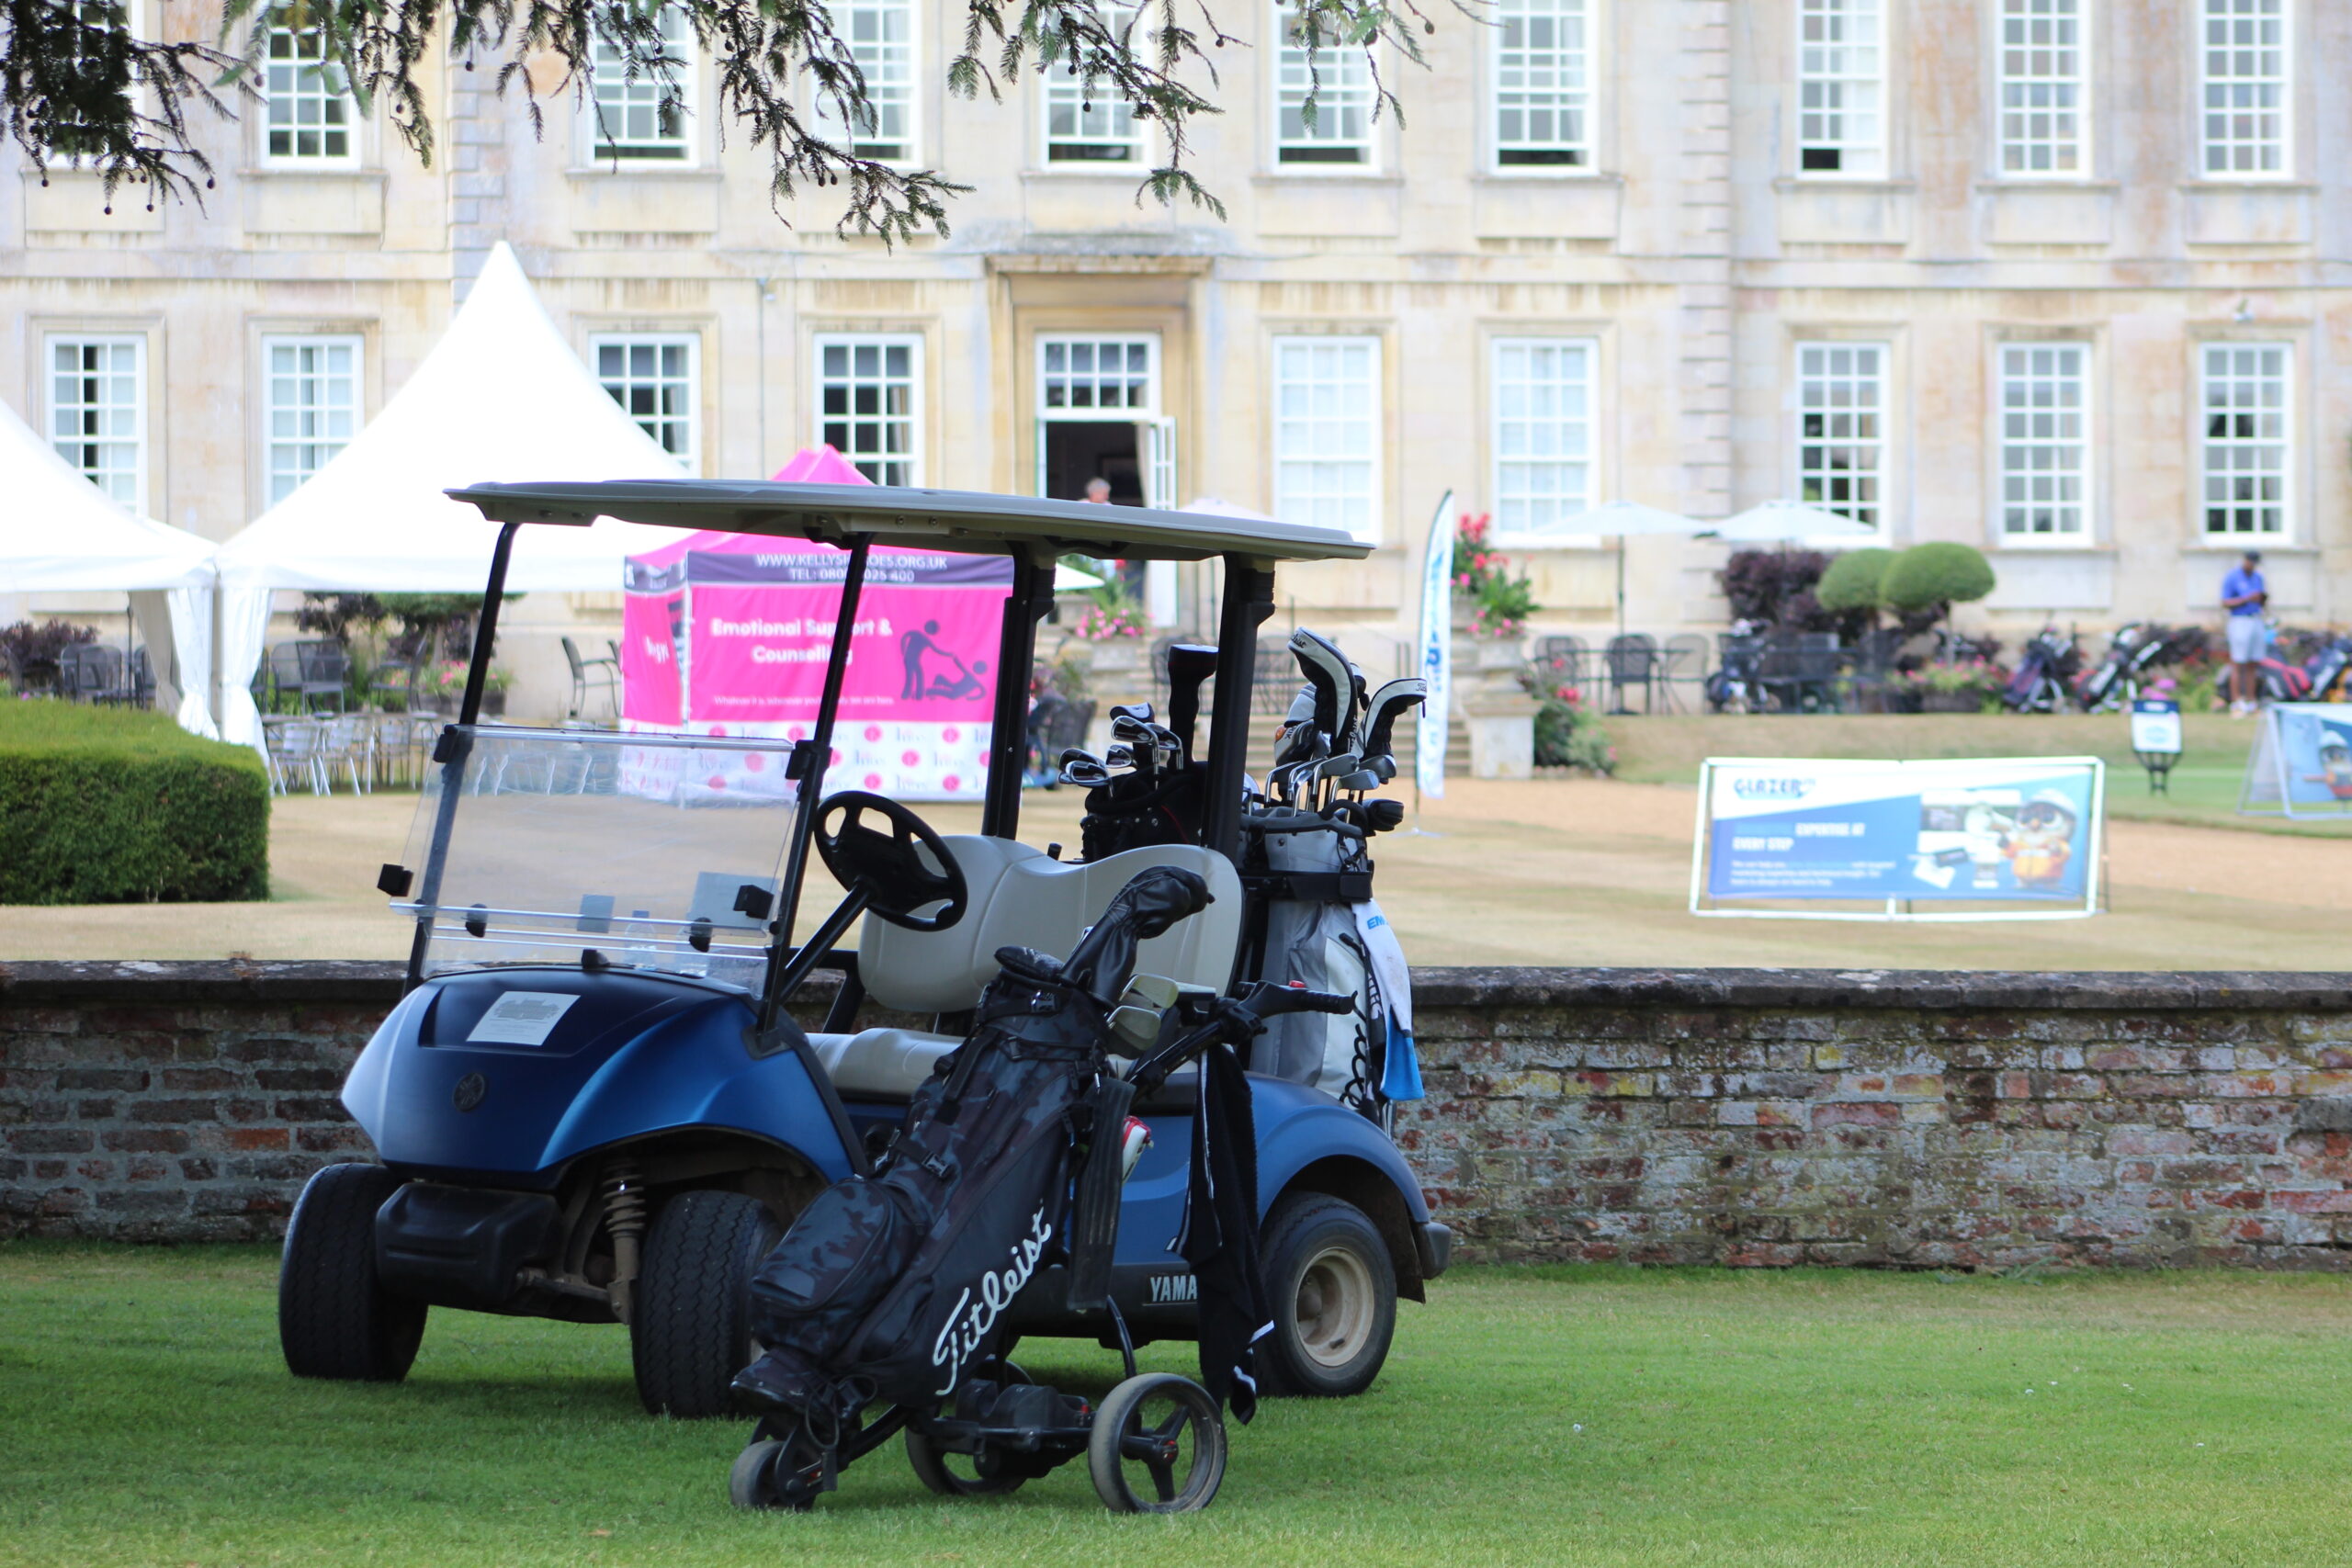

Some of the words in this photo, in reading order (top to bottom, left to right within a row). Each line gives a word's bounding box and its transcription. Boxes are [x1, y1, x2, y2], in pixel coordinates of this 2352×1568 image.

[756, 553, 947, 570] WWW.KELLYSOES.ORG.UK
[790, 567, 817, 581] TEL:
[711, 618, 801, 636] Emotional
[806, 618, 875, 639] Suport
[878, 618, 893, 636] &
[752, 645, 853, 665] Counsellig
[1150, 1274, 1198, 1303] YAMA
[932, 1205, 1052, 1396] Titleist
